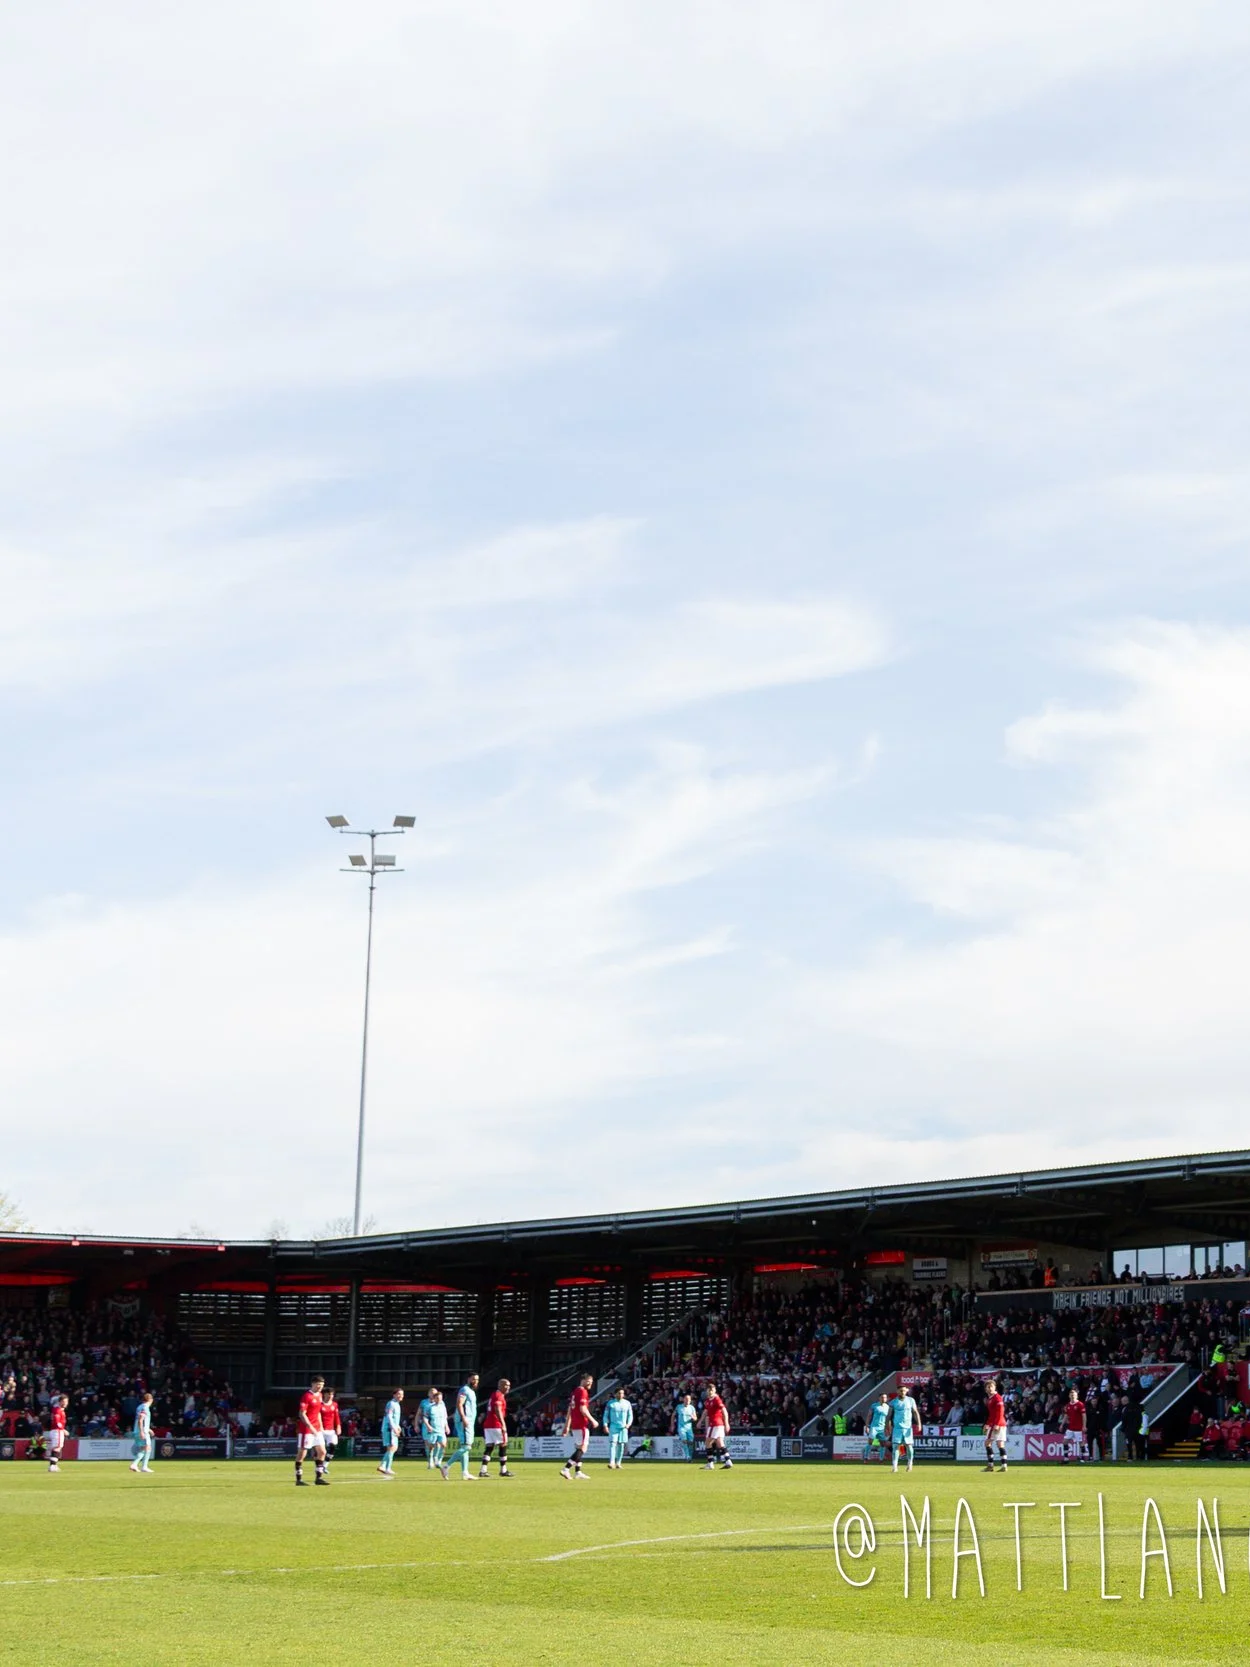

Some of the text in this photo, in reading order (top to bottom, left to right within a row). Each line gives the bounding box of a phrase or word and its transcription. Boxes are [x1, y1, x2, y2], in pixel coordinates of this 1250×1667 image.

[1081, 1290, 1111, 1305] FRIENDS
[1114, 1289, 1128, 1304] NOT
[913, 1438, 954, 1447] ILLSTONE
[962, 1439, 974, 1451] my
